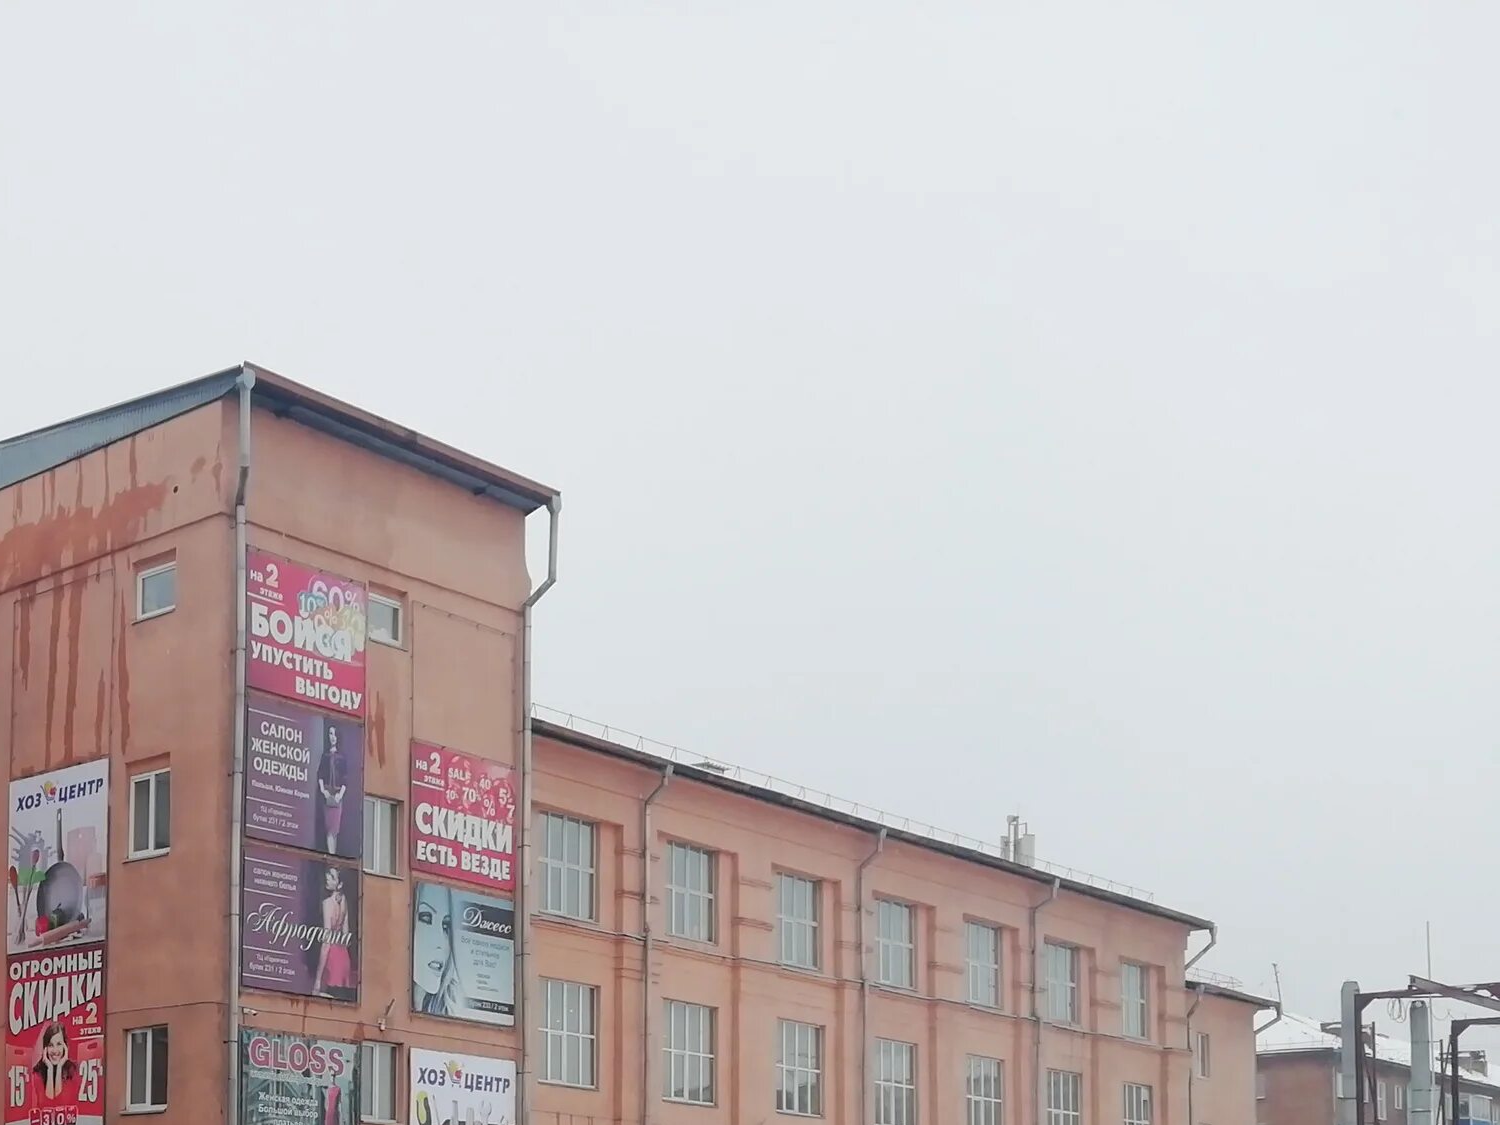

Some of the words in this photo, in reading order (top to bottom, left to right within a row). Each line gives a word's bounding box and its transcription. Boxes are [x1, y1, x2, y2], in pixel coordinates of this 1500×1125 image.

[250, 569, 263, 583] на
[266, 563, 279, 588] 2
[259, 587, 283, 601] этаже
[250, 640, 333, 681] УПУСТИТЬ
[295, 676, 362, 710] ВЫГОДУ
[260, 721, 303, 743] САЛОН
[251, 737, 310, 764] ЖЕНСКОЙ
[415, 759, 428, 771] на
[429, 752, 441, 775] 2
[253, 757, 308, 782] ОДЕЖДЫ
[16, 793, 42, 812] ХОЗ
[58, 778, 104, 804] ЦЕНТР
[415, 802, 513, 855] СКИДКИ
[416, 840, 458, 868] ЕСТЬ
[461, 850, 510, 880] ВЕЗДЕ
[462, 906, 512, 934] Джесс
[9, 950, 103, 981] ОГРОМНЫЕ
[9, 970, 102, 1036] СКИДКИ
[72, 1015, 83, 1026] на
[85, 1002, 97, 1025] 2
[79, 1026, 102, 1036] этаже
[248, 1037, 345, 1076] GLOSS
[417, 1066, 446, 1086] ХОЗ
[464, 1072, 510, 1094] ЦЕНТР
[258, 1091, 291, 1106] Женская
[291, 1097, 318, 1109] одежда
[258, 1103, 292, 1116] Большой
[293, 1108, 318, 1119] выбор
